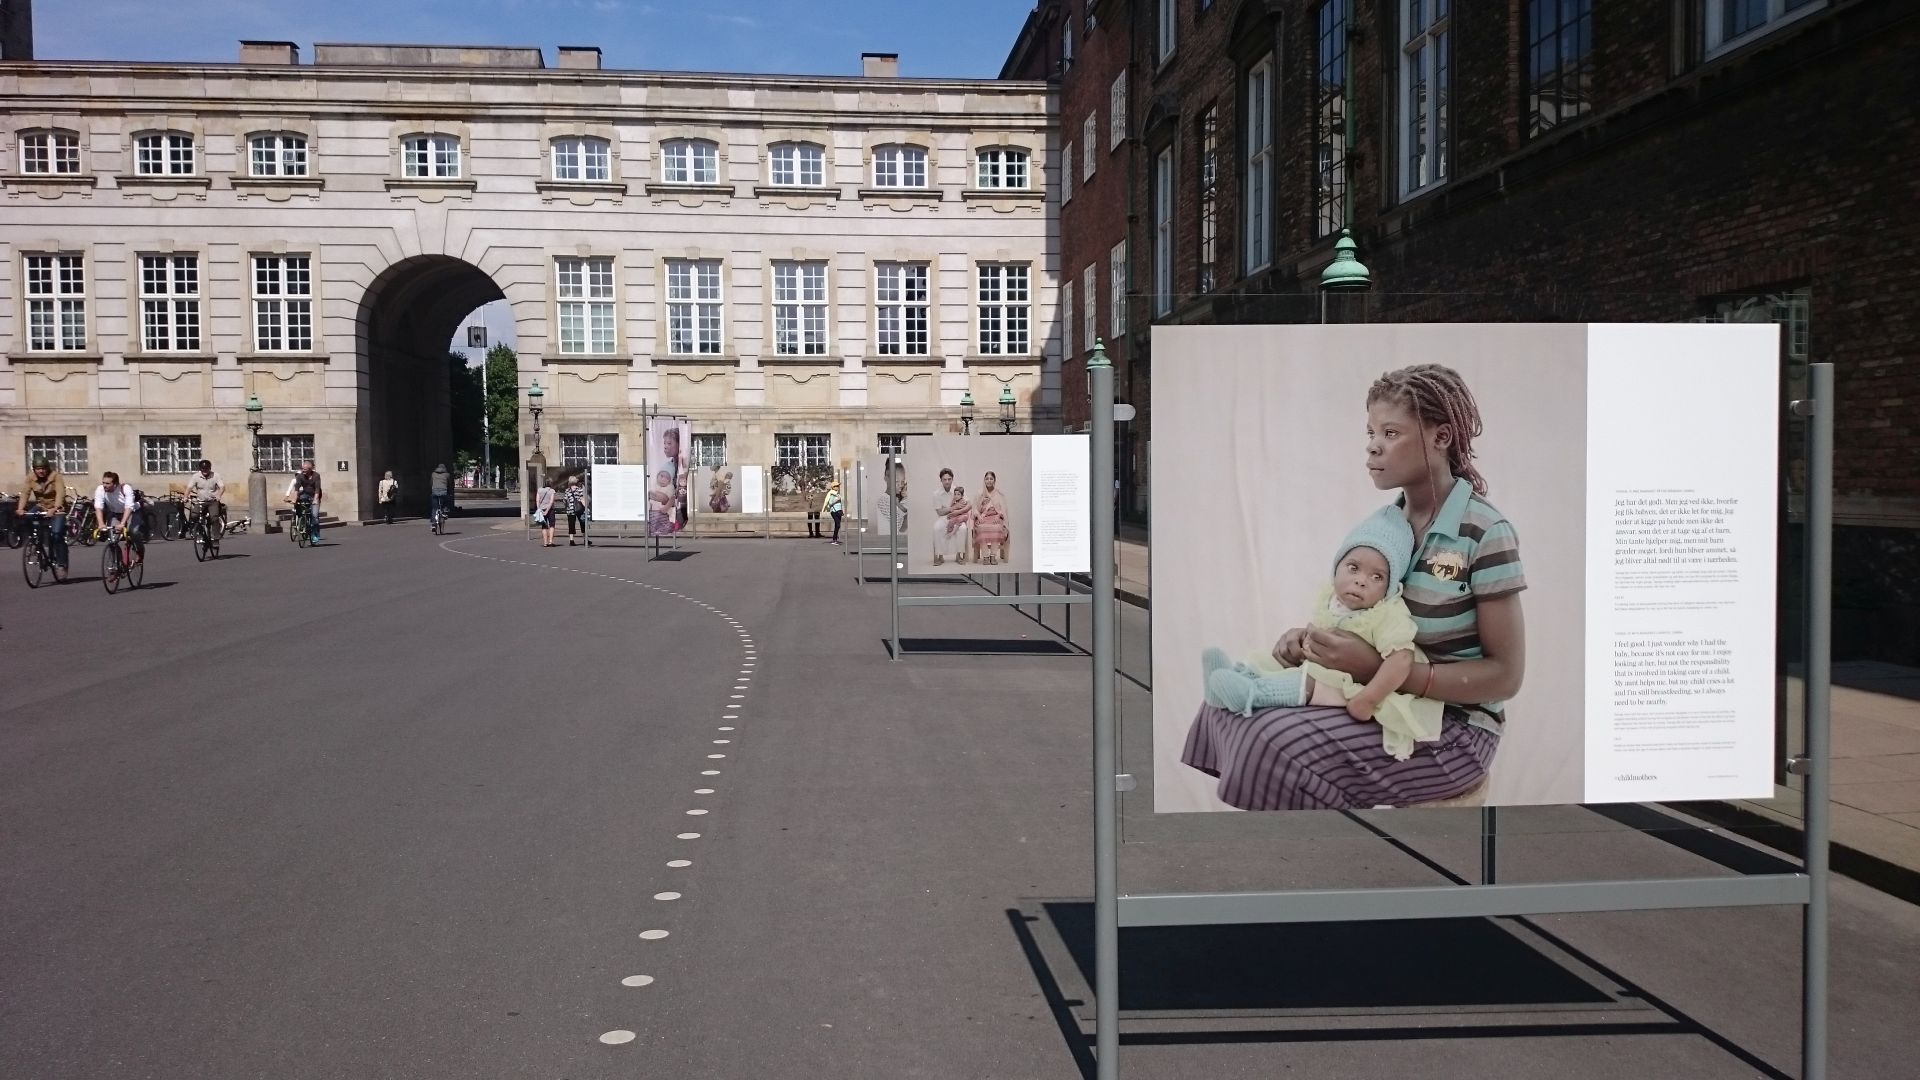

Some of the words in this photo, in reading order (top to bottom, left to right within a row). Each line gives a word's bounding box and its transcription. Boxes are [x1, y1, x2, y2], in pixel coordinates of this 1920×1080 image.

[1615, 498, 1625, 508] Jeg
[1627, 498, 1635, 506] har
[1649, 498, 1663, 507] godt.
[1679, 498, 1688, 507] jeg
[1717, 497, 1738, 505] hvorfor
[1615, 508, 1624, 517] jeg
[1678, 507, 1690, 515] ikke
[1725, 507, 1734, 516] Jeg
[1616, 518, 1632, 527] nyder
[1641, 517, 1656, 527] kigge
[1678, 527, 1690, 536] tage
[1692, 527, 1700, 536] sig
[1646, 537, 1667, 546] hjælper
[1698, 536, 1708, 544] mit
[1615, 547, 1636, 556] græder
[1675, 546, 1687, 554] hun
[1688, 546, 1704, 554] bliver
[1615, 557, 1624, 566] jeg
[1659, 556, 1672, 564] nødt
[1651, 639, 1663, 649] just
[1688, 639, 1699, 648] why
[1705, 638, 1716, 646] had
[1615, 650, 1630, 659] baby,
[1632, 649, 1655, 657] because
[1717, 648, 1732, 657] enjoy
[1615, 659, 1637, 669] looking
[1669, 658, 1678, 666] not
[1691, 658, 1730, 667] responsibility
[1668, 668, 1687, 677] taking
[1640, 678, 1656, 687] helps
[1691, 677, 1705, 685] child
[1615, 688, 1626, 696] and
[1707, 686, 1726, 696] always
[1647, 697, 1668, 706] nearby.
